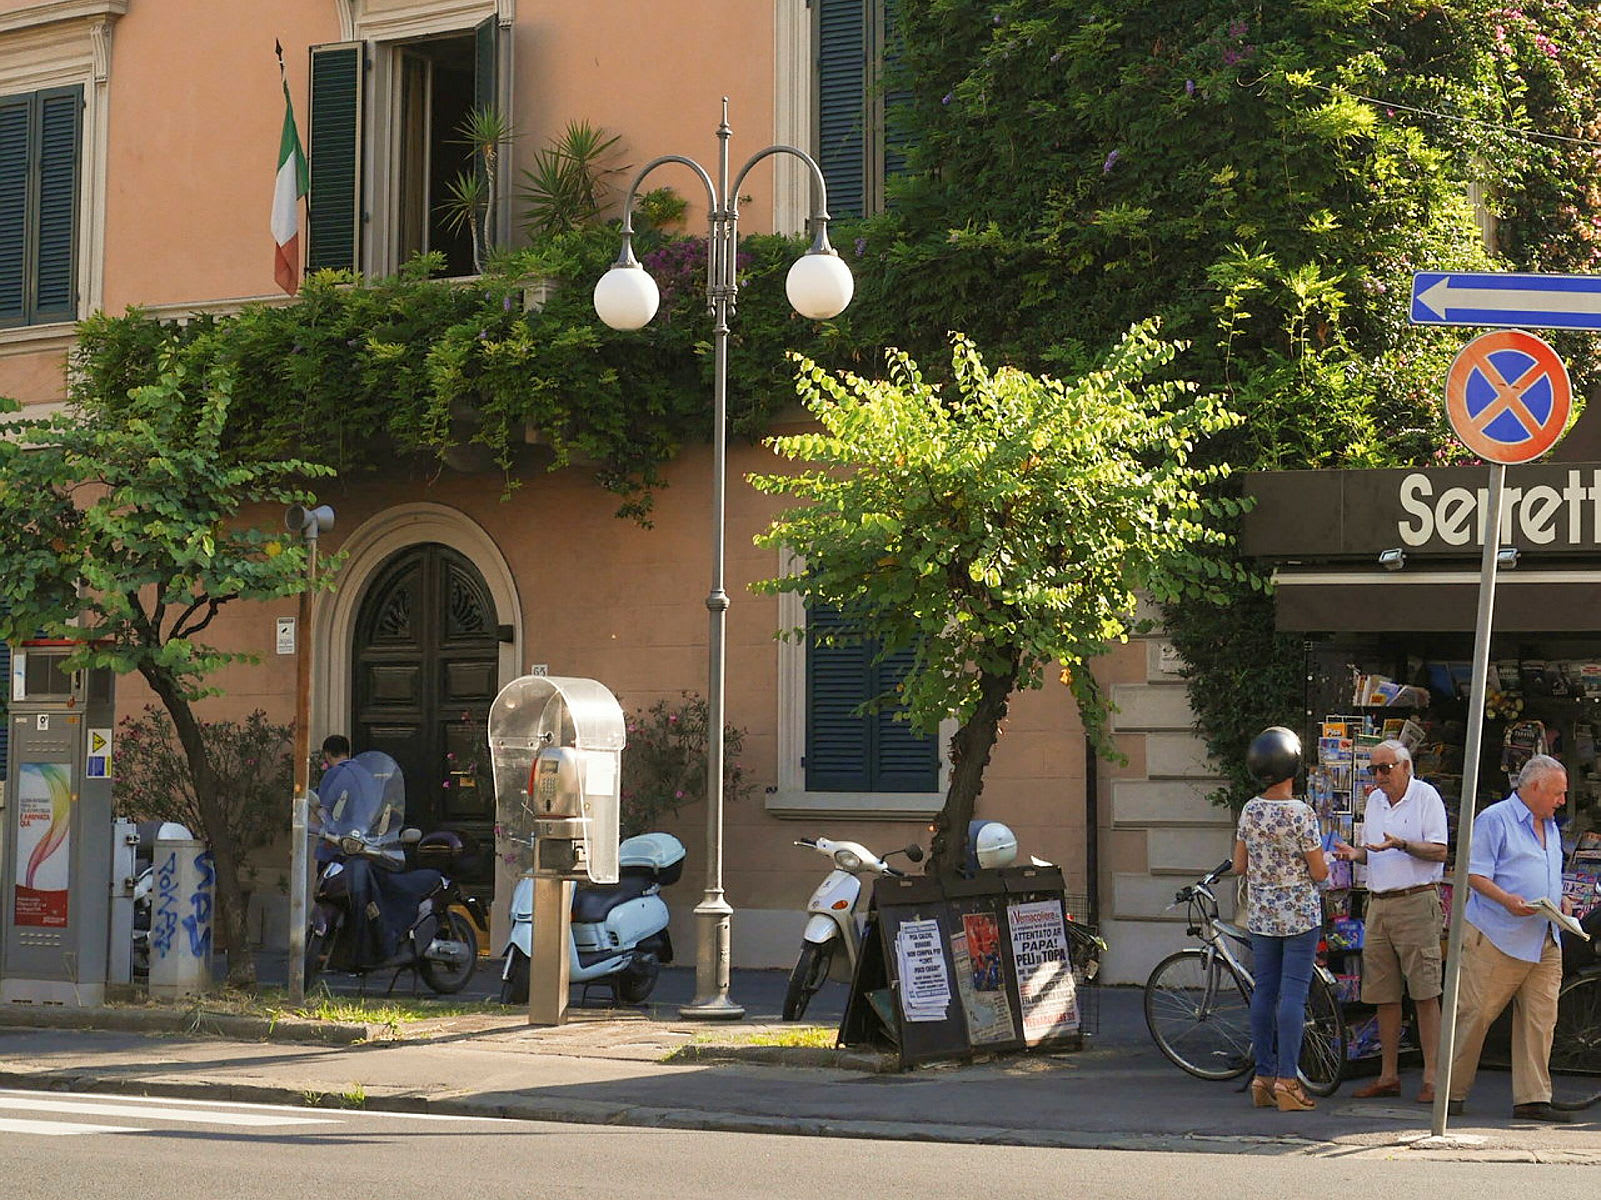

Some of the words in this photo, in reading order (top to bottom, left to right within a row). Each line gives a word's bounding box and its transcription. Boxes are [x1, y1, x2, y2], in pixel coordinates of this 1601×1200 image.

[1013, 929, 1052, 942] ATTENTATO
[1022, 938, 1058, 952] PAPA!
[1016, 952, 1036, 967] PELI
[1041, 948, 1067, 963] TOPA
